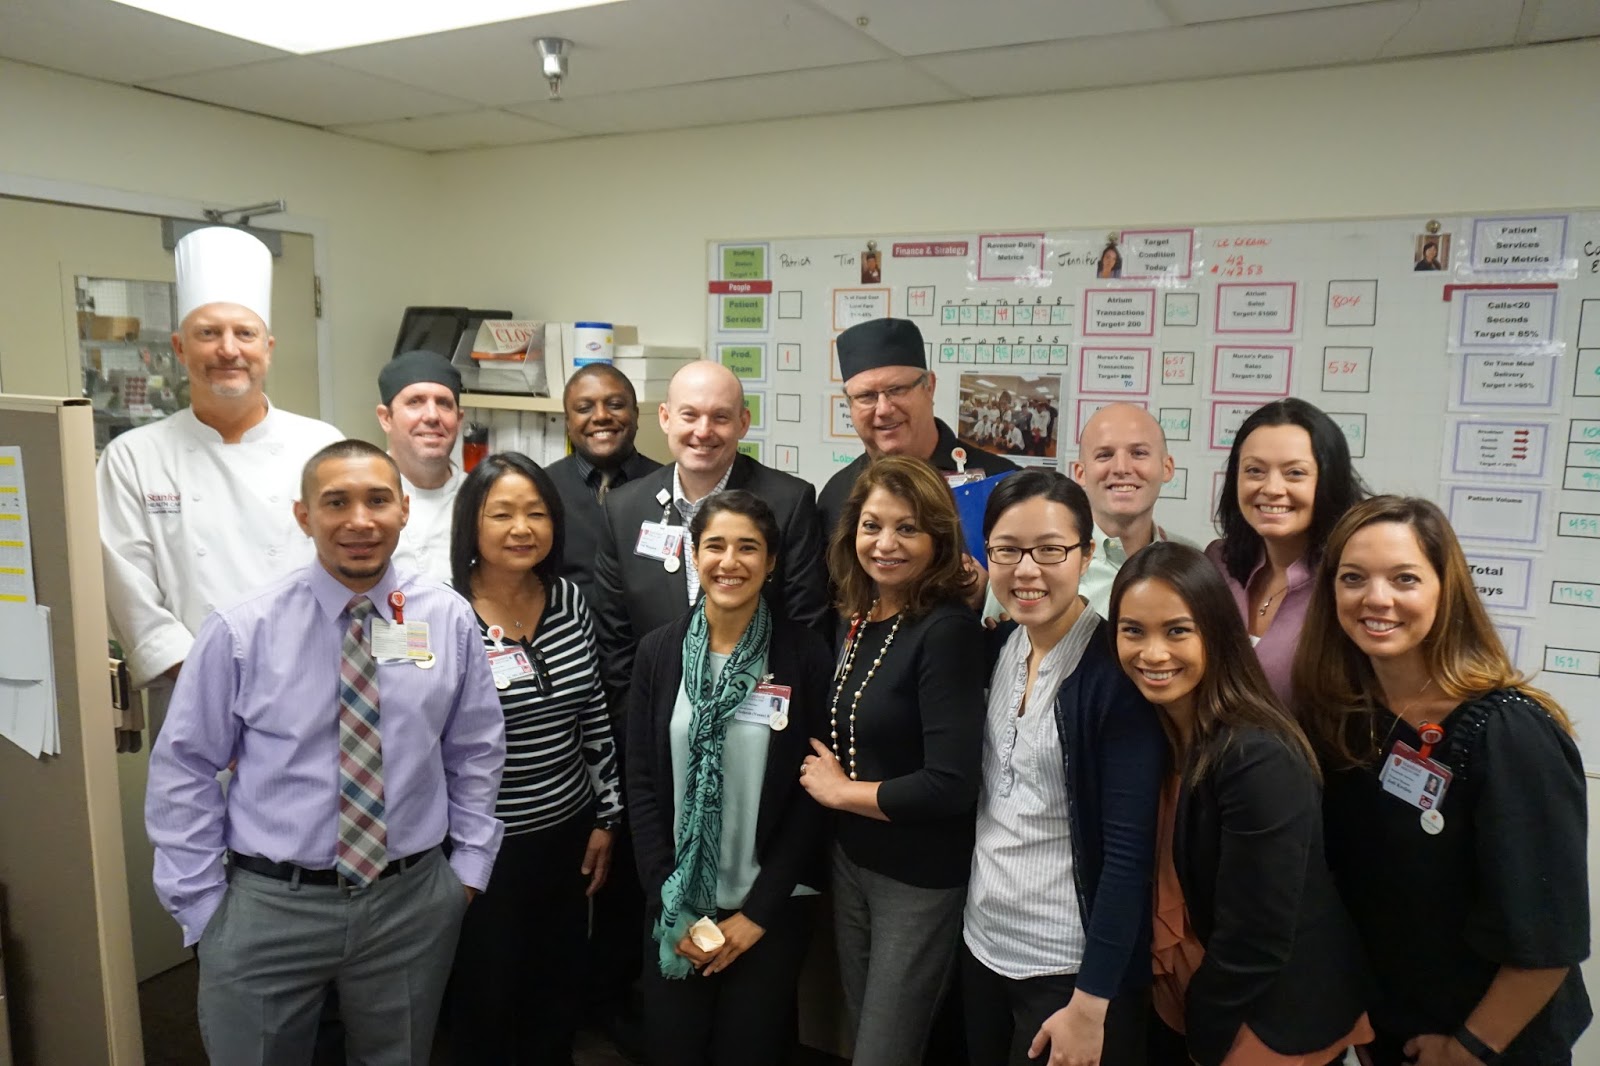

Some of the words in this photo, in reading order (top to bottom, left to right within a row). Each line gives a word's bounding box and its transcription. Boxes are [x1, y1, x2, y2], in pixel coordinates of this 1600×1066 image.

[1501, 226, 1538, 235] Patient
[1018, 241, 1036, 250] Daily
[1143, 238, 1169, 246] Target
[1495, 241, 1540, 249] Services
[895, 246, 924, 255] Finance
[926, 246, 932, 254] &
[934, 246, 966, 255] Strategy
[780, 253, 812, 268] Patrick
[834, 253, 855, 267] Tim
[1226, 254, 1244, 266] 42
[1484, 256, 1509, 264] Daily
[1144, 264, 1168, 272] Today
[728, 282, 752, 292] People
[729, 300, 758, 308] Patient
[1331, 294, 1362, 308] 804
[1487, 301, 1531, 310] Calls<20
[726, 316, 762, 324] Services
[1474, 330, 1506, 339] Target
[730, 350, 752, 358] Prod.
[730, 364, 753, 373] Team
[1328, 360, 1358, 374] 537
[1569, 518, 1598, 533] 459
[1469, 565, 1504, 576] Total
[1474, 586, 1504, 596] rays
[1554, 656, 1580, 668] 1521
